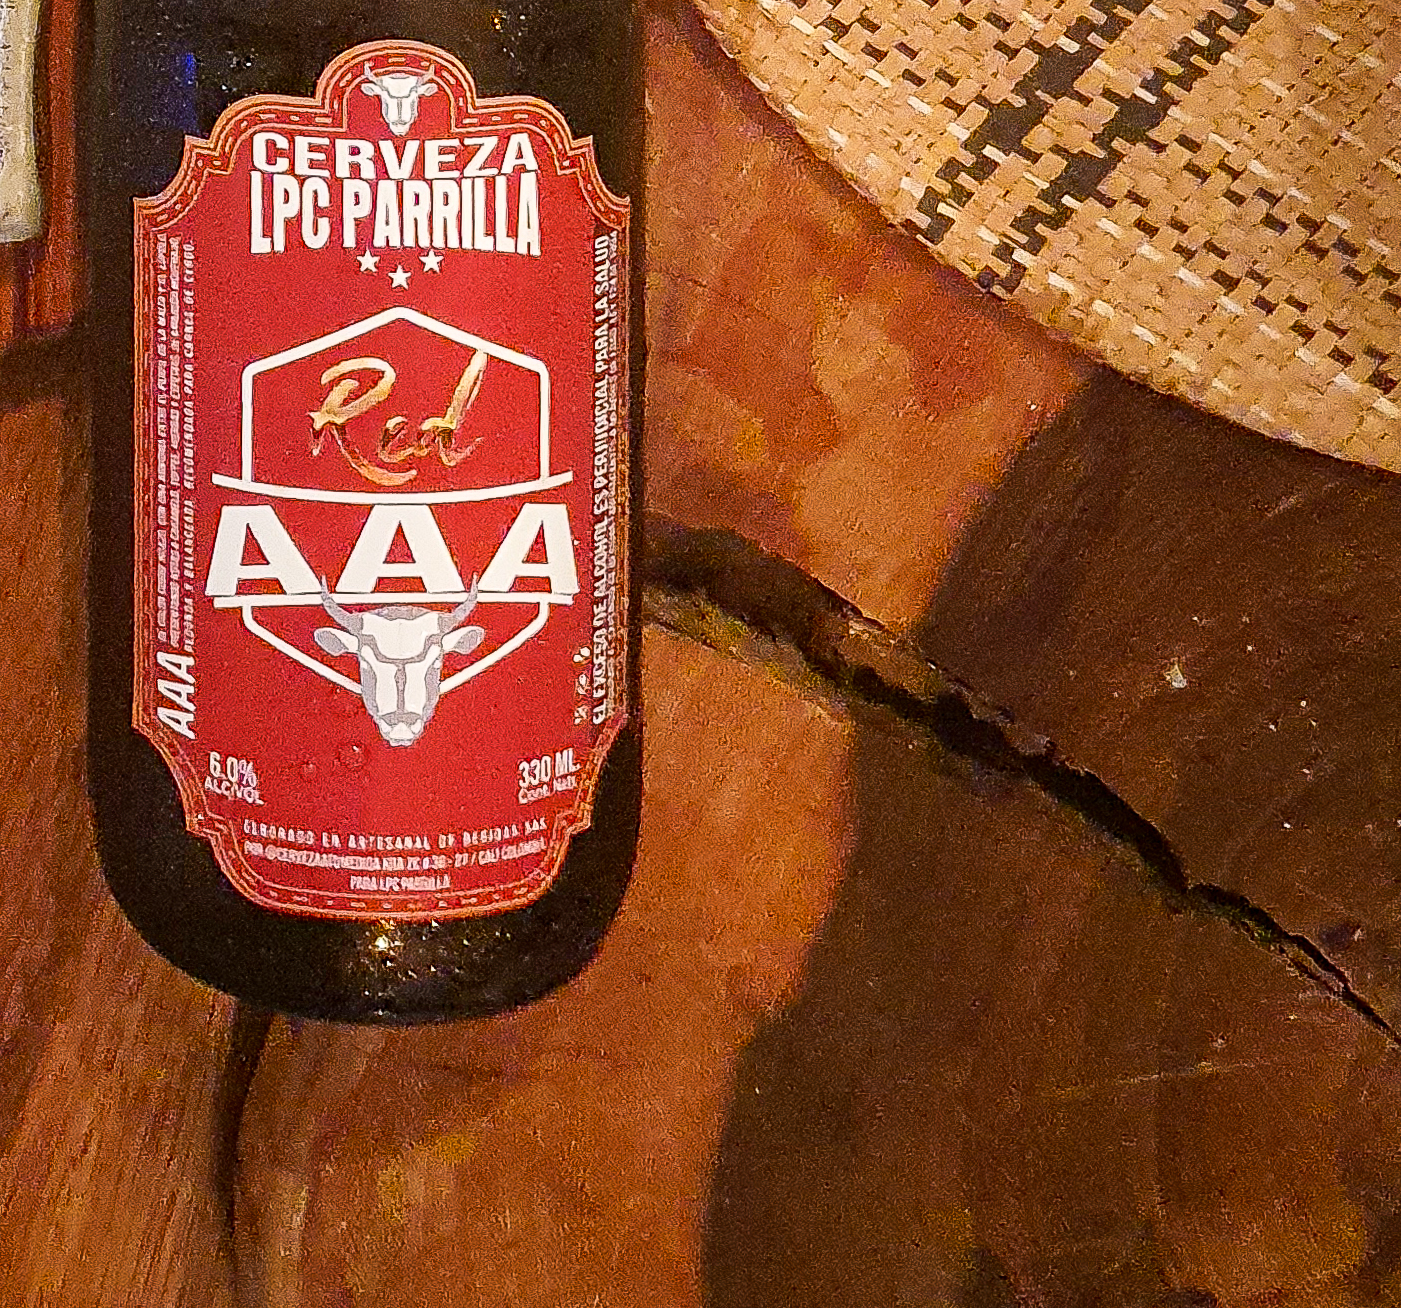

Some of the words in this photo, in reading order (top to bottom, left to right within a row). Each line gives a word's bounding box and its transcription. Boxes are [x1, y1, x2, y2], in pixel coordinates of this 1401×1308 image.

[251, 132, 539, 180] CERVEZA
[249, 171, 331, 254] LPC
[342, 173, 541, 257] PARRILLA
[594, 235, 610, 295] SALUD
[594, 295, 609, 323] LA
[594, 323, 609, 374] PARA
[307, 349, 489, 487] Red
[594, 374, 609, 489] PERJUDICIAL
[593, 488, 609, 515] ES
[204, 502, 580, 596] AAA
[593, 515, 608, 597] ALCOHOL
[593, 598, 607, 627] DE
[592, 628, 607, 698] EXCESO
[156, 651, 196, 740] AAA
[592, 698, 607, 725] EL
[209, 751, 257, 787] 6.0%
[518, 754, 552, 788] 330
[348, 834, 431, 851] ARTESANAL
